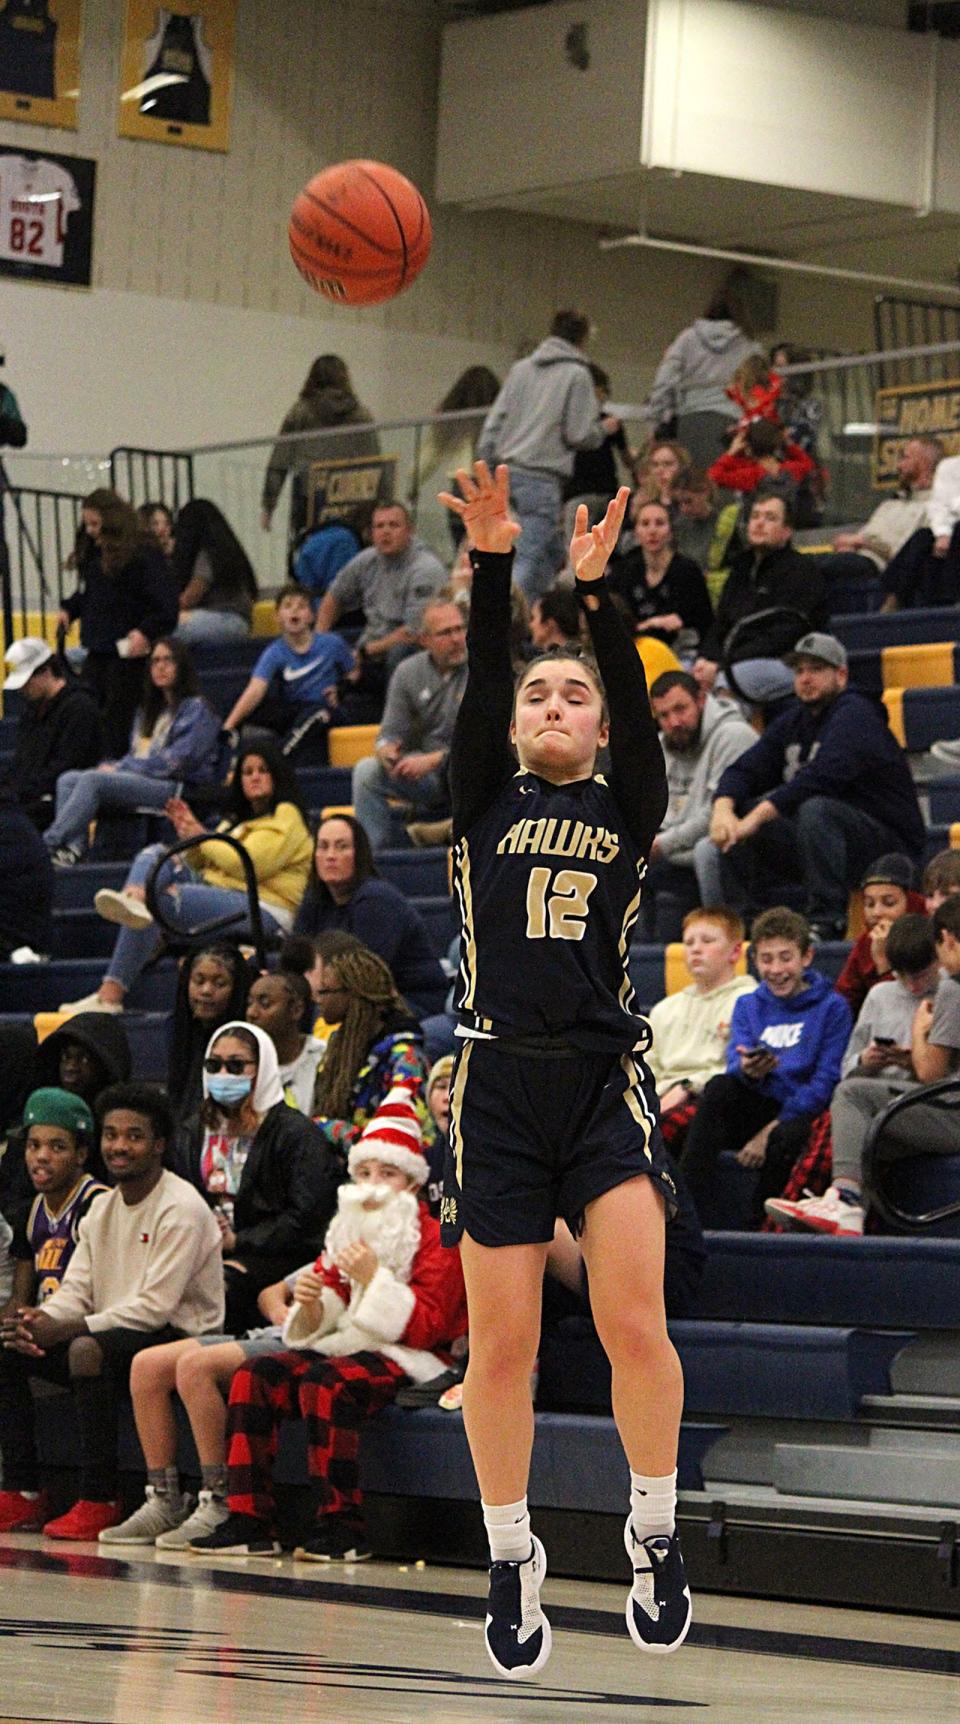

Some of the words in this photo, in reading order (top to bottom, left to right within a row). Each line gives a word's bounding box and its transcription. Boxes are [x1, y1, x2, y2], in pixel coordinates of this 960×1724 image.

[10, 217, 44, 256] 82
[496, 818, 620, 864] HAWKS
[526, 866, 598, 941] 12
